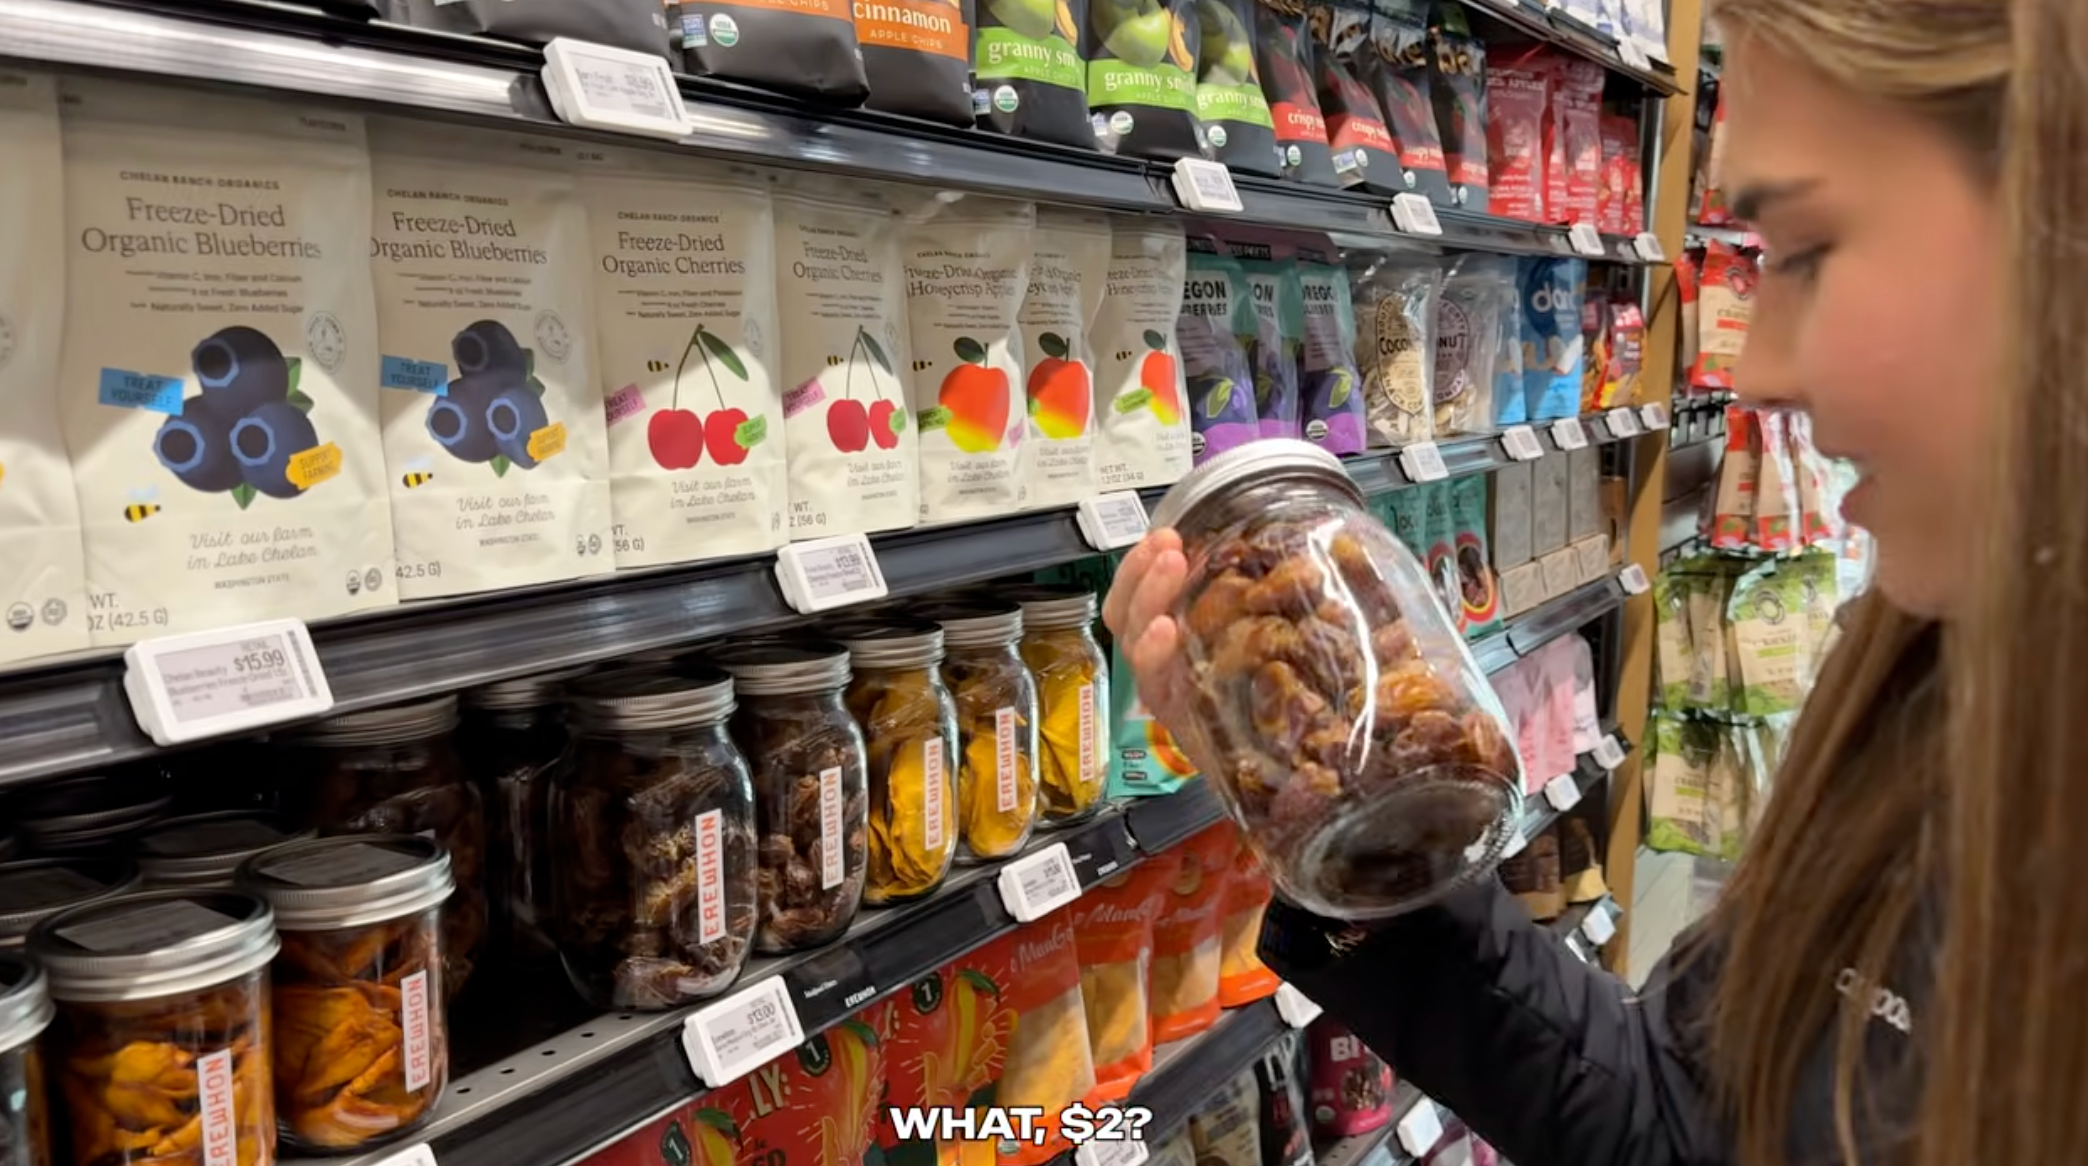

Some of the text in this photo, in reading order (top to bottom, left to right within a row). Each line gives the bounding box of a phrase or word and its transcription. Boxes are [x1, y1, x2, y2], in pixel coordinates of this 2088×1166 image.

[854, 1, 951, 33] cinnamon
[870, 29, 944, 49] APPLE CHIPS
[988, 41, 1051, 63] granny
[1104, 70, 1162, 91] granny
[1196, 88, 1248, 110] granny
[119, 170, 170, 184] CHELAN
[217, 178, 280, 191] ORGANICS
[126, 196, 286, 228] Freeze-Dried
[392, 210, 517, 238] Freeze-Dried
[81, 226, 322, 260] Organic Blueberries
[449, 239, 549, 265] Blueberries
[618, 231, 726, 252] Freeze-Dried
[802, 241, 868, 263] Freeze-Dried
[602, 254, 746, 278] Organic Cherries
[792, 261, 883, 283] Organic Cherries
[240, 288, 288, 299] Blueberries
[1184, 279, 1227, 300] EGON
[151, 302, 194, 315] Naturally
[196, 302, 225, 313] Sweet,
[228, 302, 249, 313] Zero
[252, 303, 278, 314] Added
[1379, 336, 1408, 356] COCO
[401, 362, 432, 377] TREAT
[123, 376, 164, 391] TREAT
[390, 373, 438, 391] YOURSELF
[111, 388, 172, 408] YOURSELF
[456, 496, 493, 512] Visit
[498, 497, 521, 508] our
[456, 516, 474, 530] in
[478, 512, 512, 528] Lake
[190, 525, 315, 549] Visit our farm
[632, 537, 645, 551] G)
[187, 544, 318, 570] in Lake Chelan
[428, 561, 442, 578] G)
[90, 591, 119, 610] WT.
[108, 610, 150, 631] (42.5
[153, 606, 169, 628] G)
[233, 649, 285, 673] $15.99
[1000, 712, 1016, 809] EREWHON
[927, 743, 942, 846] EREWHON
[823, 772, 840, 884] EREWHON
[700, 814, 720, 939] EREWHON
[746, 1001, 776, 1026] $13.00
[407, 976, 427, 1085] EREWHON
[750, 1062, 792, 1119] LY:
